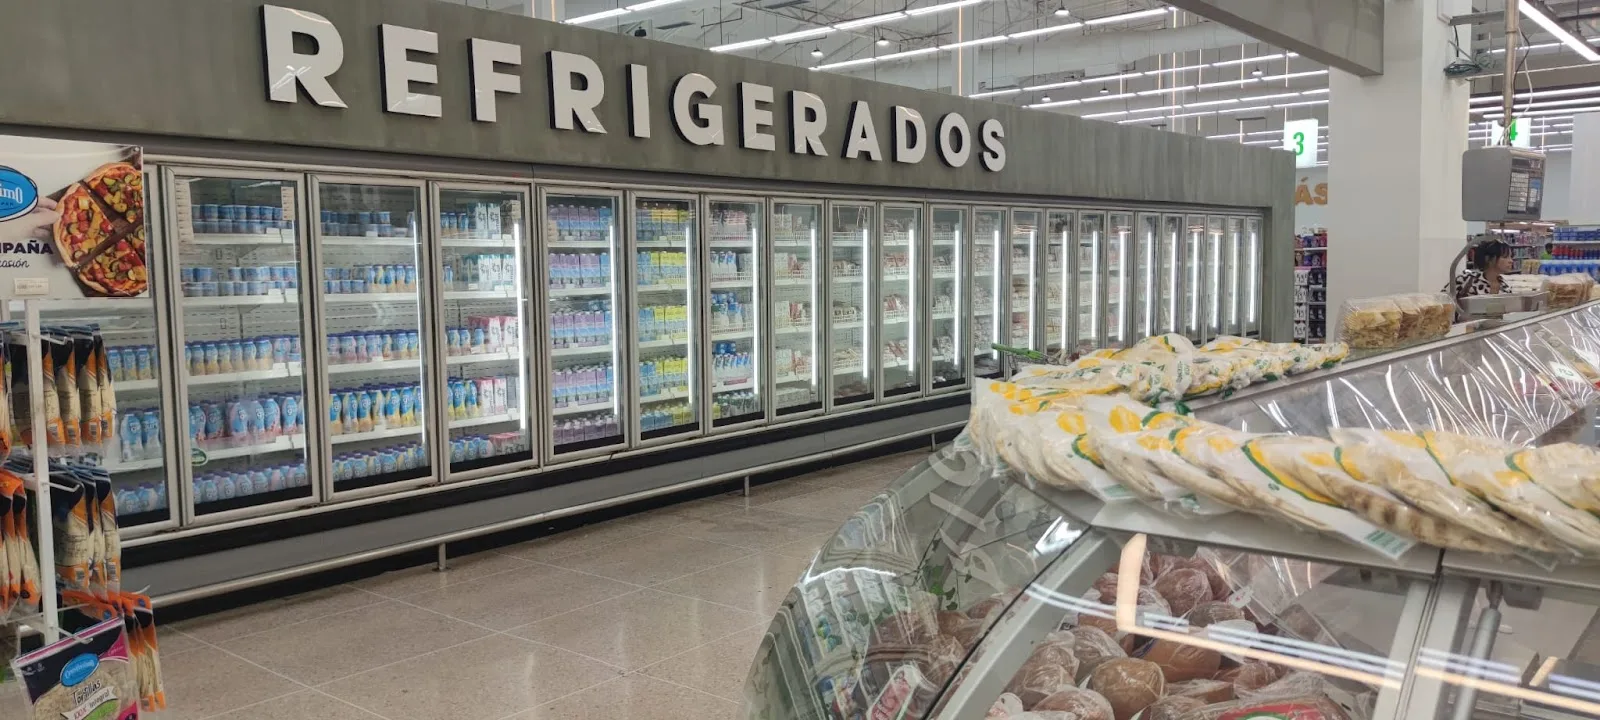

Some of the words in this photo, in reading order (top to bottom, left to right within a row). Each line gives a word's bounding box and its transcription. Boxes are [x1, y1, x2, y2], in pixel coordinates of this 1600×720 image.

[260, 4, 1007, 173] REFRIGERADOS
[1292, 131, 1305, 156] 3
[0, 239, 54, 255] PAÑA
